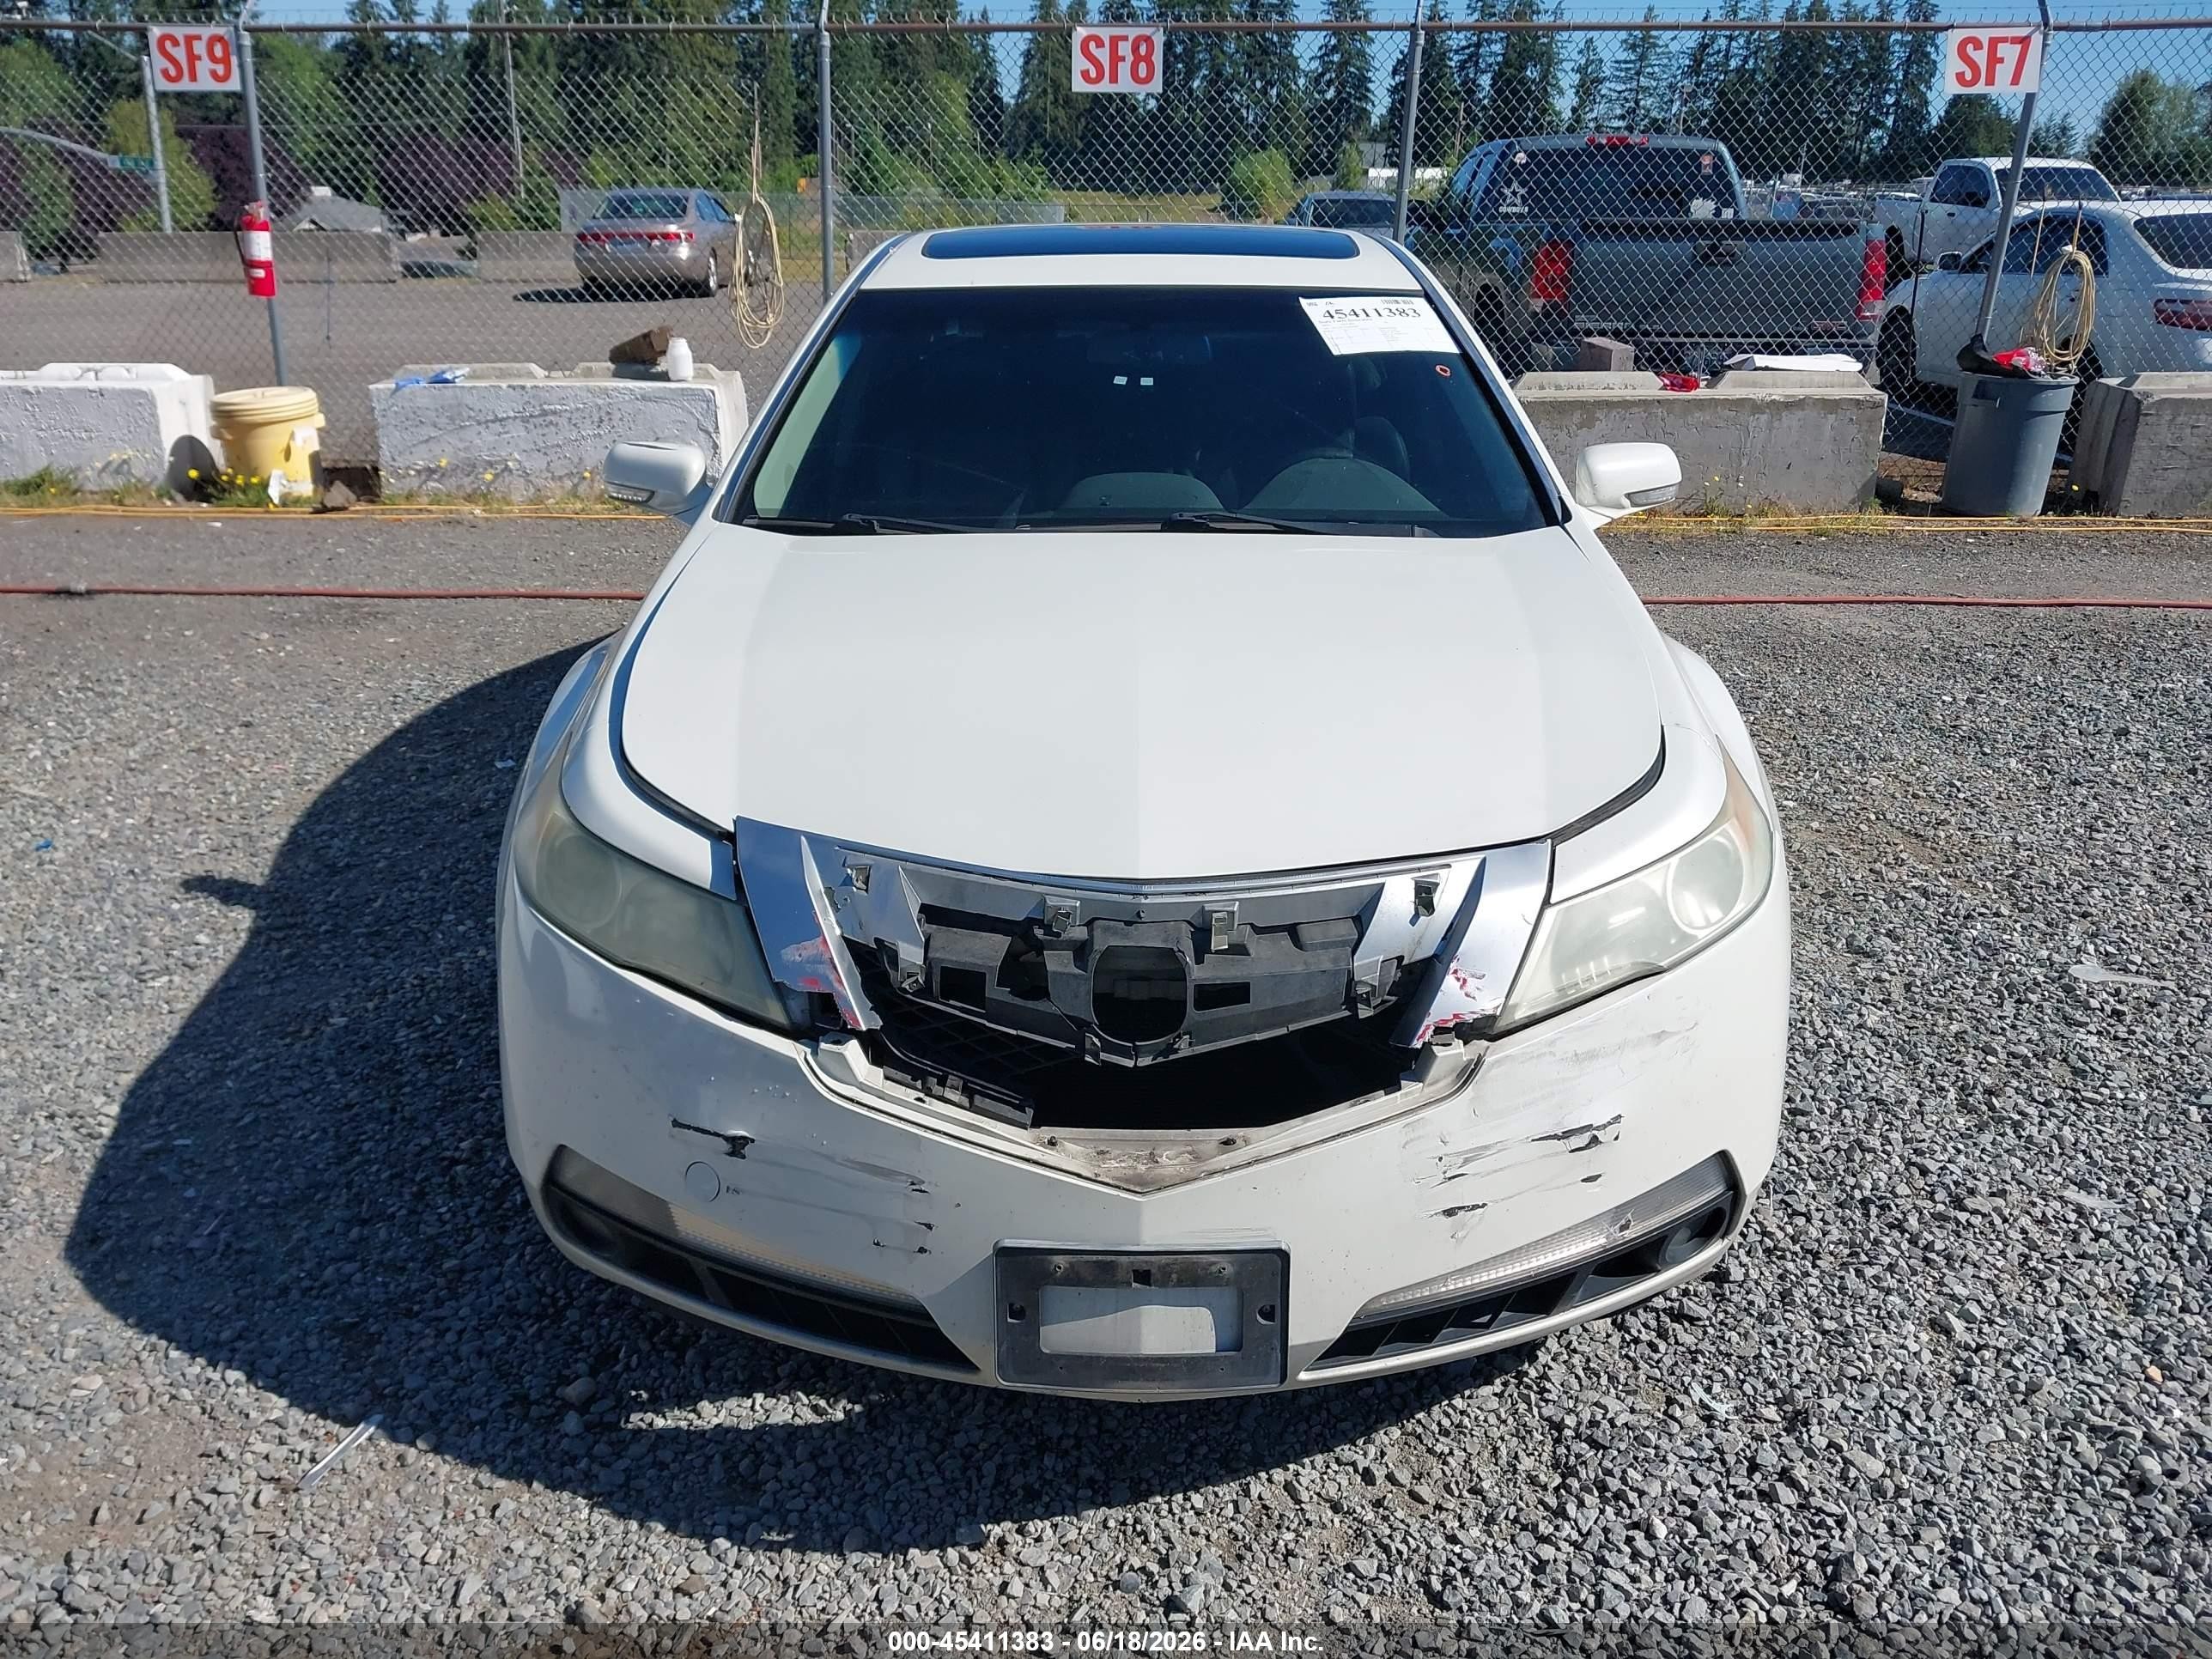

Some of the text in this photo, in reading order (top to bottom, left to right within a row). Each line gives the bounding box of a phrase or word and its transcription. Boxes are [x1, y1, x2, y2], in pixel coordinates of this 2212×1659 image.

[155, 33, 232, 83] SF9
[1079, 33, 1156, 85] SF8
[1954, 35, 2033, 88] SF7
[1322, 307, 1421, 319] 45411383
